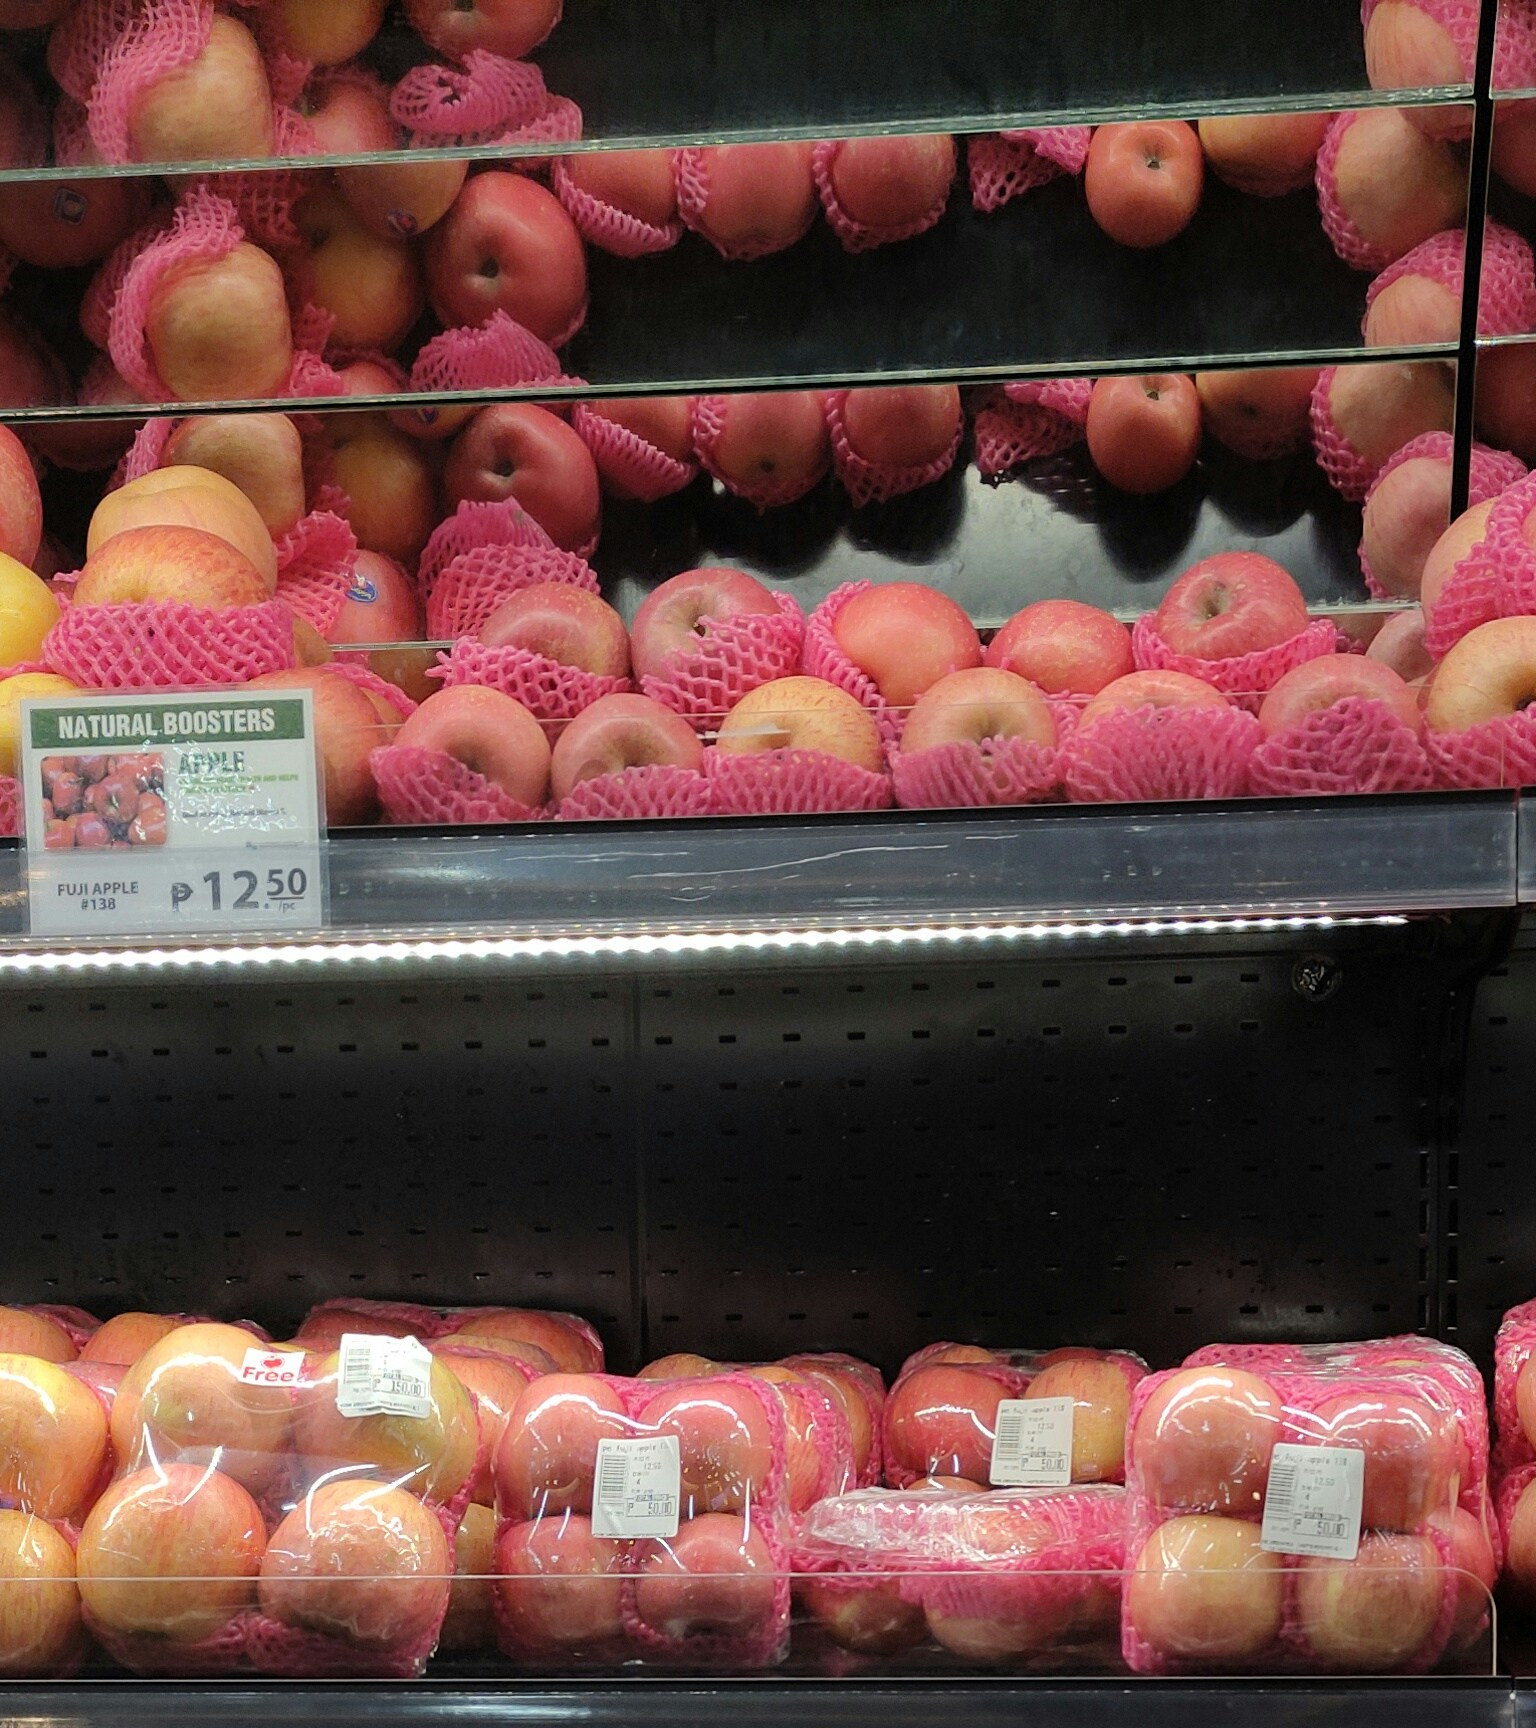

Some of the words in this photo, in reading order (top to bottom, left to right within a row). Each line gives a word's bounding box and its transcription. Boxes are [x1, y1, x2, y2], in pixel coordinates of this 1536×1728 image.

[58, 714, 162, 739] NATURAL
[164, 708, 276, 735] BOOSTERS
[178, 751, 245, 775] APPLE
[58, 882, 89, 896] FUJI
[92, 881, 139, 896] APPLE
[243, 1366, 294, 1382] Free
